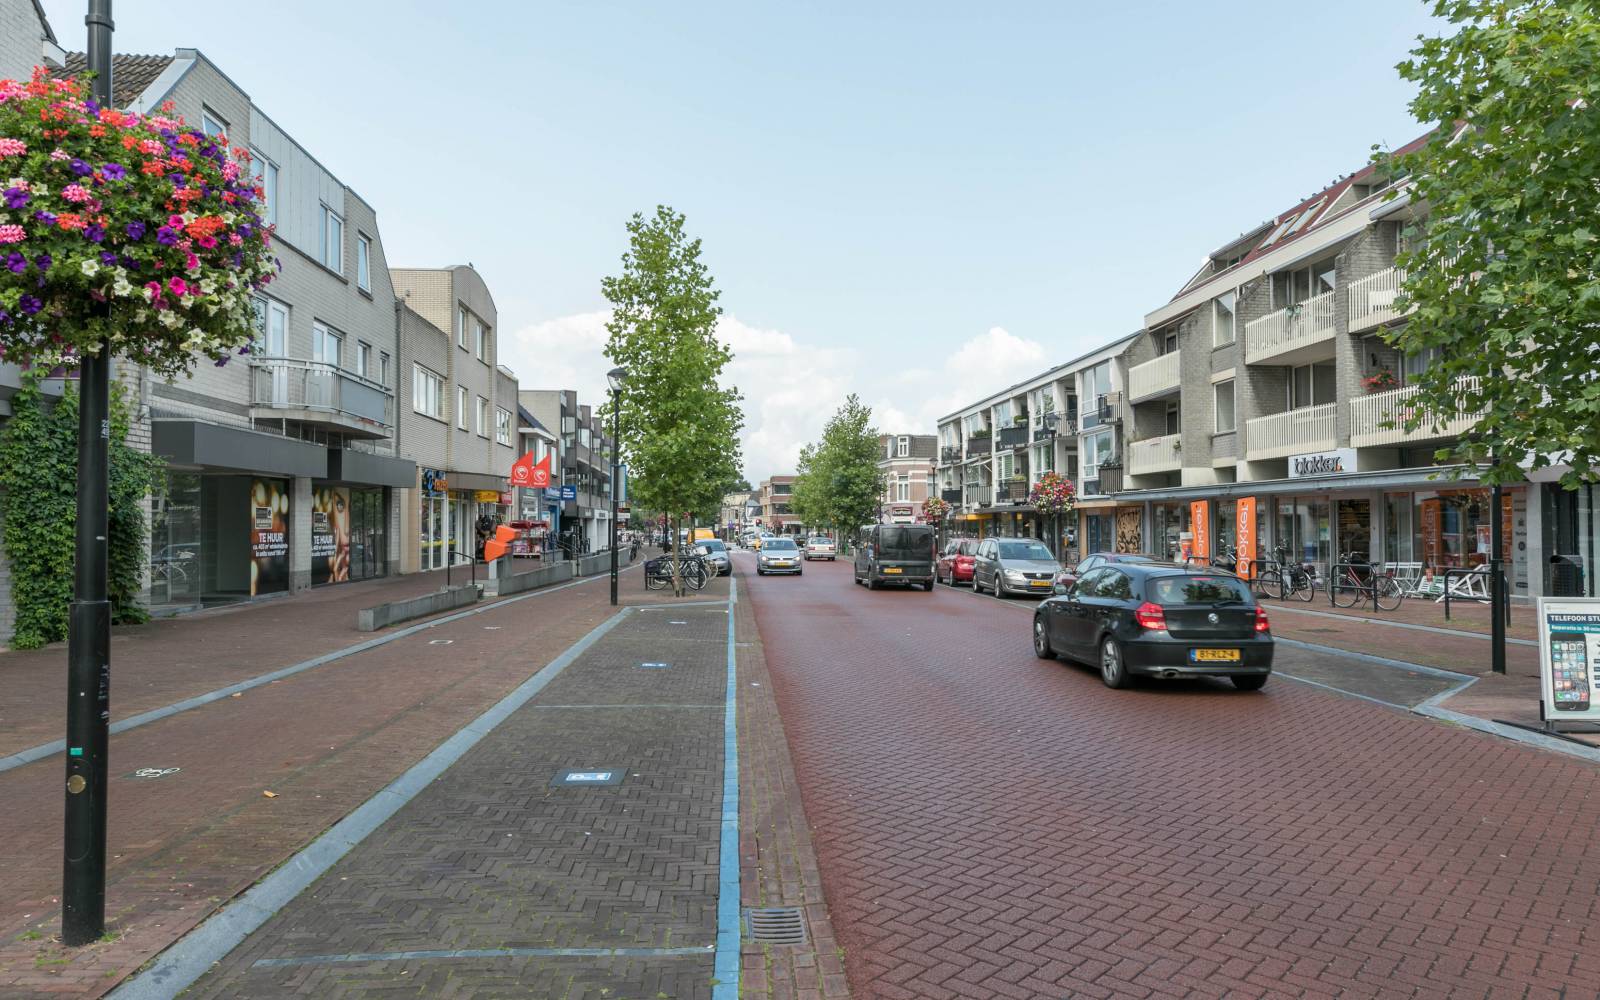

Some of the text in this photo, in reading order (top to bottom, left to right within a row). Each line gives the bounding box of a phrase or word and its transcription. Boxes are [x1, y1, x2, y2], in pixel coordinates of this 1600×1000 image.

[258, 532, 284, 543] TE HUUR
[313, 535, 320, 545] TE
